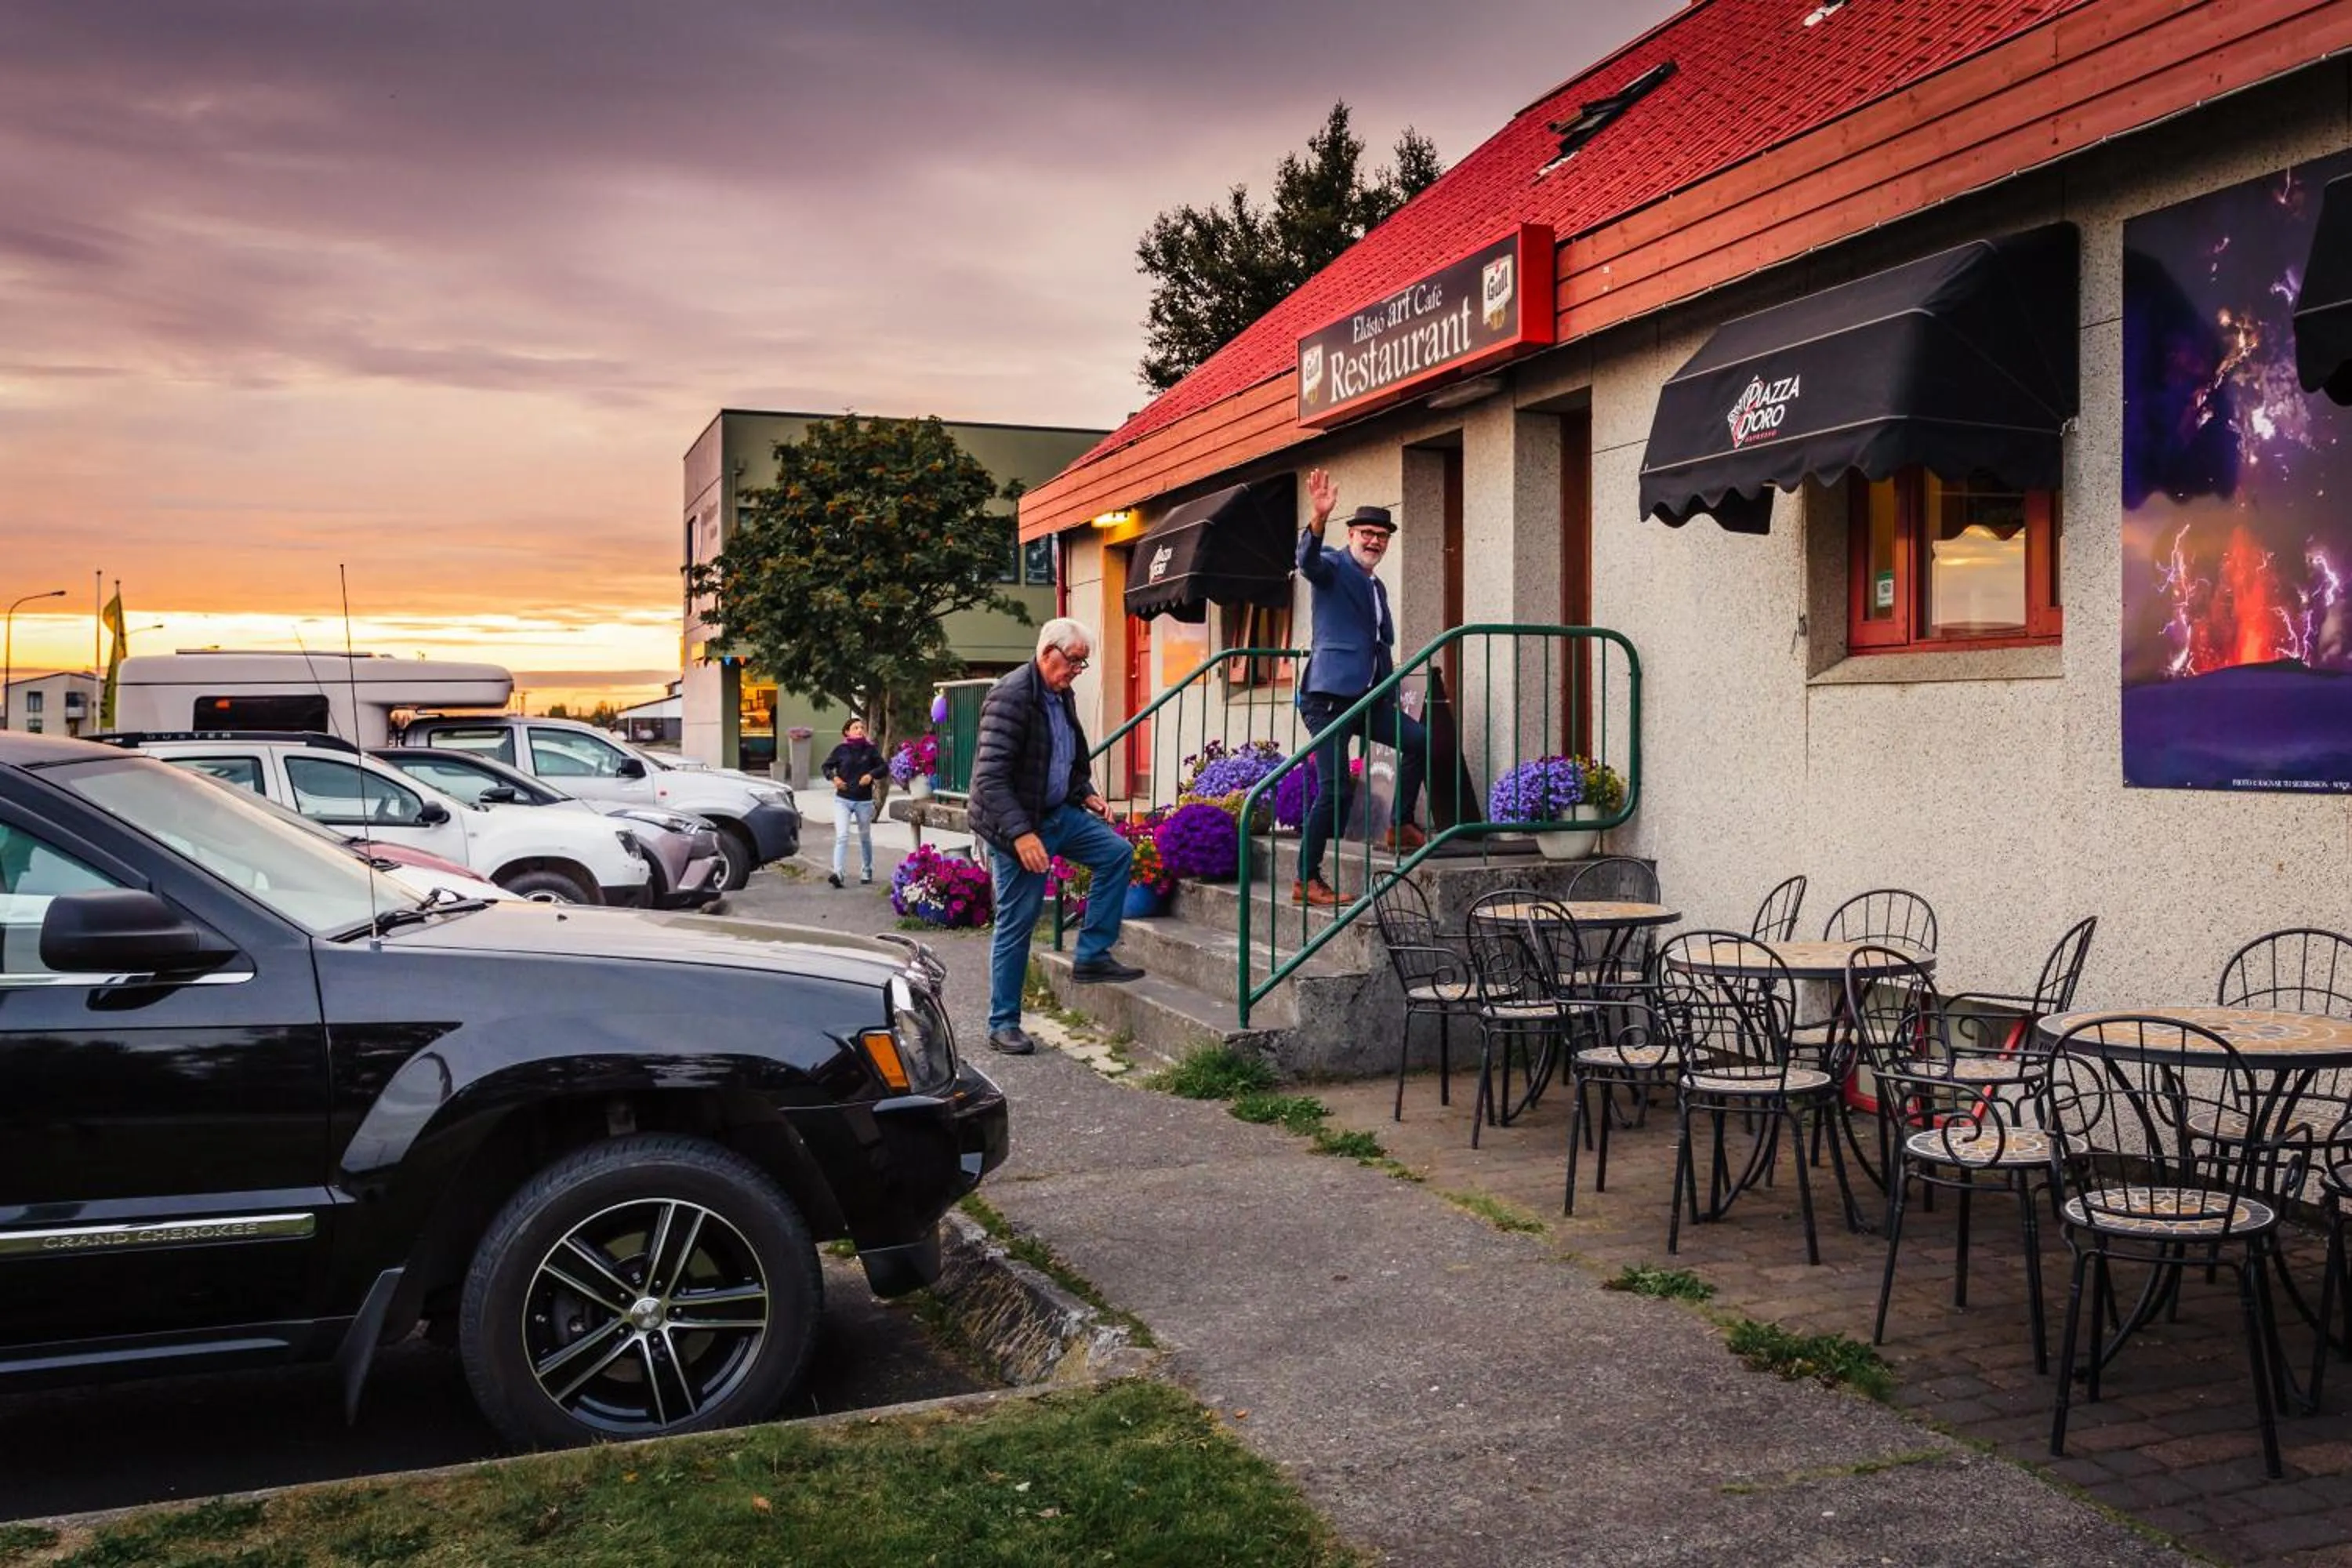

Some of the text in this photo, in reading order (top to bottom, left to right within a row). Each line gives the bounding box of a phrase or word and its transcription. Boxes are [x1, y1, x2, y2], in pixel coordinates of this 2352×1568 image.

[1414, 283, 1443, 315] Café
[1330, 296, 1472, 403] Restaurant
[42, 1223, 259, 1249] GRAND CHEROKEE
